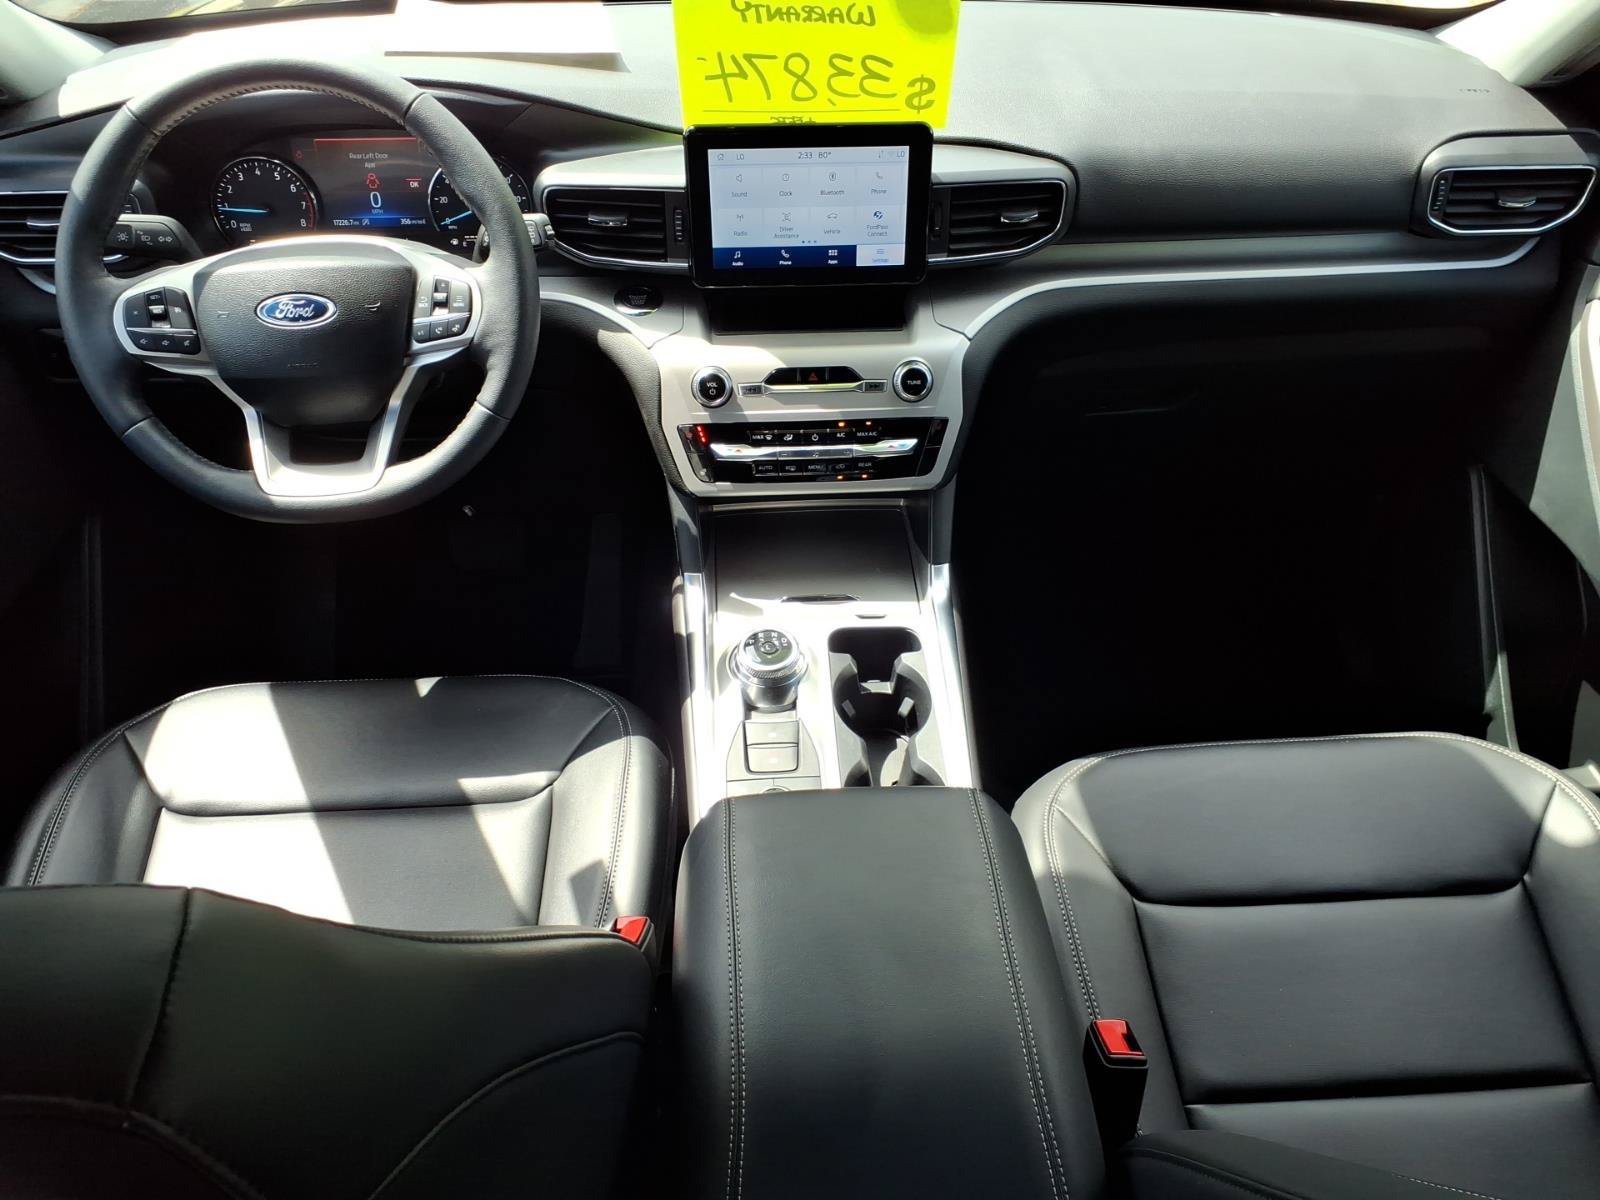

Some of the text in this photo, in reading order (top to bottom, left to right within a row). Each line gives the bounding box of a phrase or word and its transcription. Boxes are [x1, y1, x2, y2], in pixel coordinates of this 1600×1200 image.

[798, 152, 813, 160] 2:33
[238, 172, 244, 181] 3
[274, 172, 280, 180] 5
[228, 185, 233, 194] 2
[290, 184, 296, 192] 6
[370, 192, 382, 208] 0
[301, 202, 306, 210] 7
[231, 220, 236, 228] 0
[300, 219, 306, 227] 8
[276, 300, 316, 318] Ford
